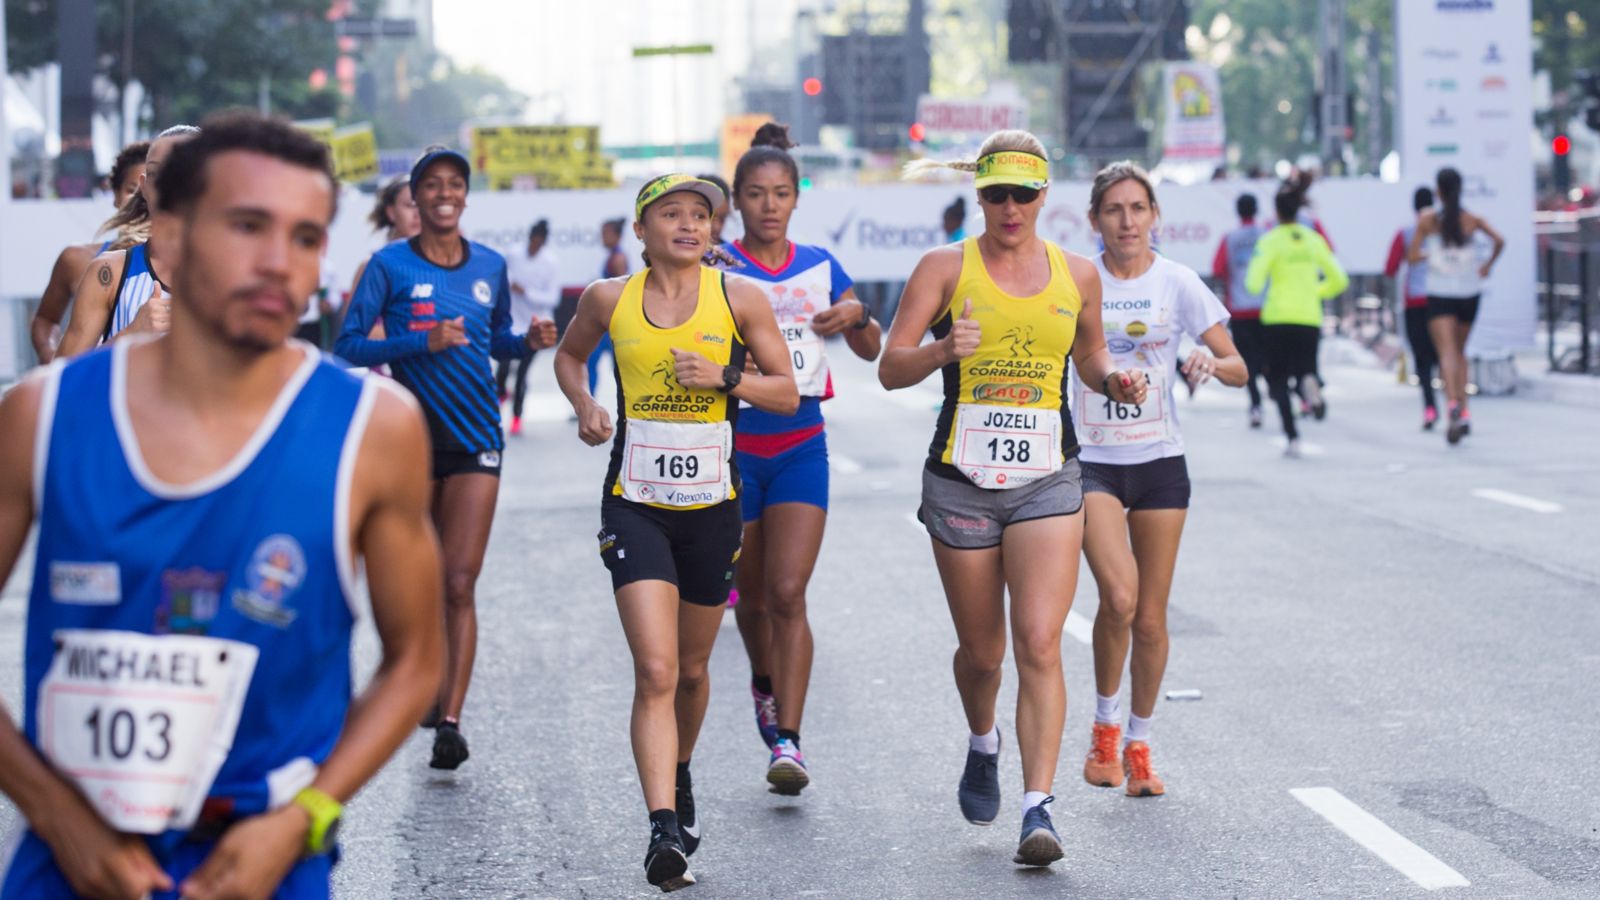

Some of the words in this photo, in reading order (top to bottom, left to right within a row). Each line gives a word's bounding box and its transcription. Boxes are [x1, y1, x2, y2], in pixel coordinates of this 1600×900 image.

[1103, 300, 1151, 310] SICOOB
[995, 360, 1031, 369] CASA
[1035, 361, 1053, 371] DO
[969, 367, 1047, 380] CORREDOR
[655, 395, 692, 404] CASA
[695, 396, 715, 405] DO
[632, 403, 710, 413] CORREDOR
[1103, 401, 1142, 420] 163
[984, 412, 1037, 430] JOZELI
[987, 437, 1030, 463] 138
[655, 454, 699, 478] 169
[676, 491, 712, 503] Rexona
[66, 645, 208, 687] MICHAEL
[85, 705, 173, 761] 103
